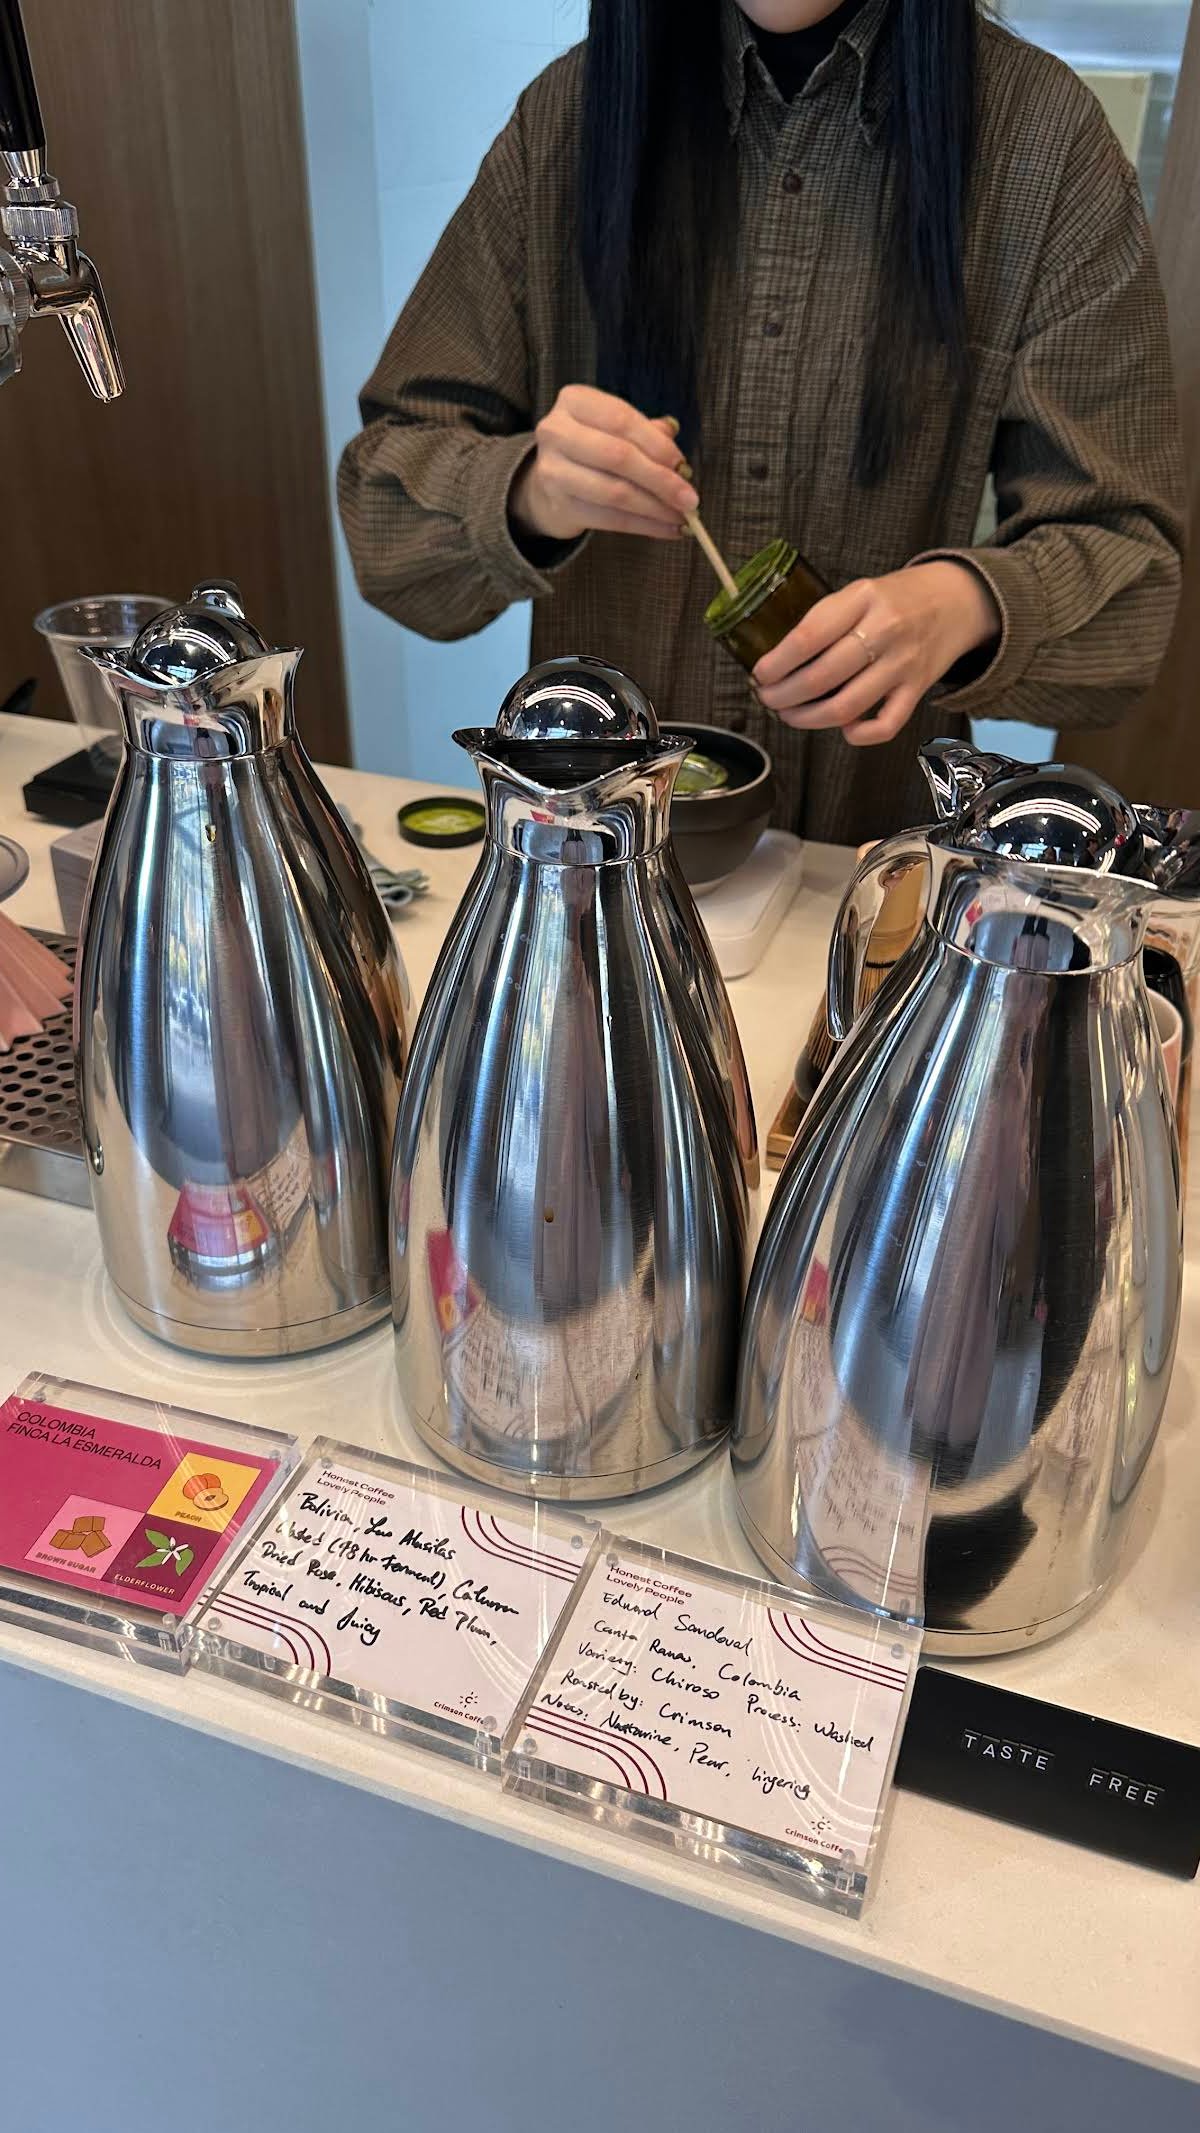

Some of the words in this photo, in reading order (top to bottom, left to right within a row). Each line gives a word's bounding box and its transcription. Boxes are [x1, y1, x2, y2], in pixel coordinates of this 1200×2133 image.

[17, 1411, 96, 1439] COLOMBIA
[6, 1422, 49, 1441] FINCA
[51, 1433, 71, 1447] LA
[72, 1439, 162, 1469] ESMERALDA
[316, 1477, 350, 1494] Lovely
[350, 1489, 386, 1506] People
[322, 1470, 359, 1487] Honest
[360, 1483, 396, 1499] Coffee
[174, 1510, 203, 1523] PEACH
[35, 1551, 67, 1566] BROWN
[66, 1560, 97, 1574] SUGAR
[114, 1573, 175, 1595] ELDERFLOWER
[262, 1540, 303, 1567] Dried
[419, 1597, 449, 1620] Red
[606, 1574, 644, 1593] Lovely
[644, 1587, 685, 1606] People
[610, 1565, 652, 1584] Honest
[652, 1580, 693, 1598] Coffee
[243, 1570, 294, 1601] Tropical
[299, 1599, 330, 1615] and
[336, 1606, 381, 1646] Juicy
[674, 1613, 753, 1657] Sandoval
[718, 1663, 802, 1701] Colombia
[433, 1701, 464, 1717] Crimson
[651, 1667, 720, 1700] Chiroso
[814, 1721, 875, 1752] Washed
[658, 1703, 732, 1738] Crimson
[964, 1733, 1050, 1771] TASTE
[1088, 1773, 1159, 1806] FREE
[785, 1828, 819, 1845] Crimson
